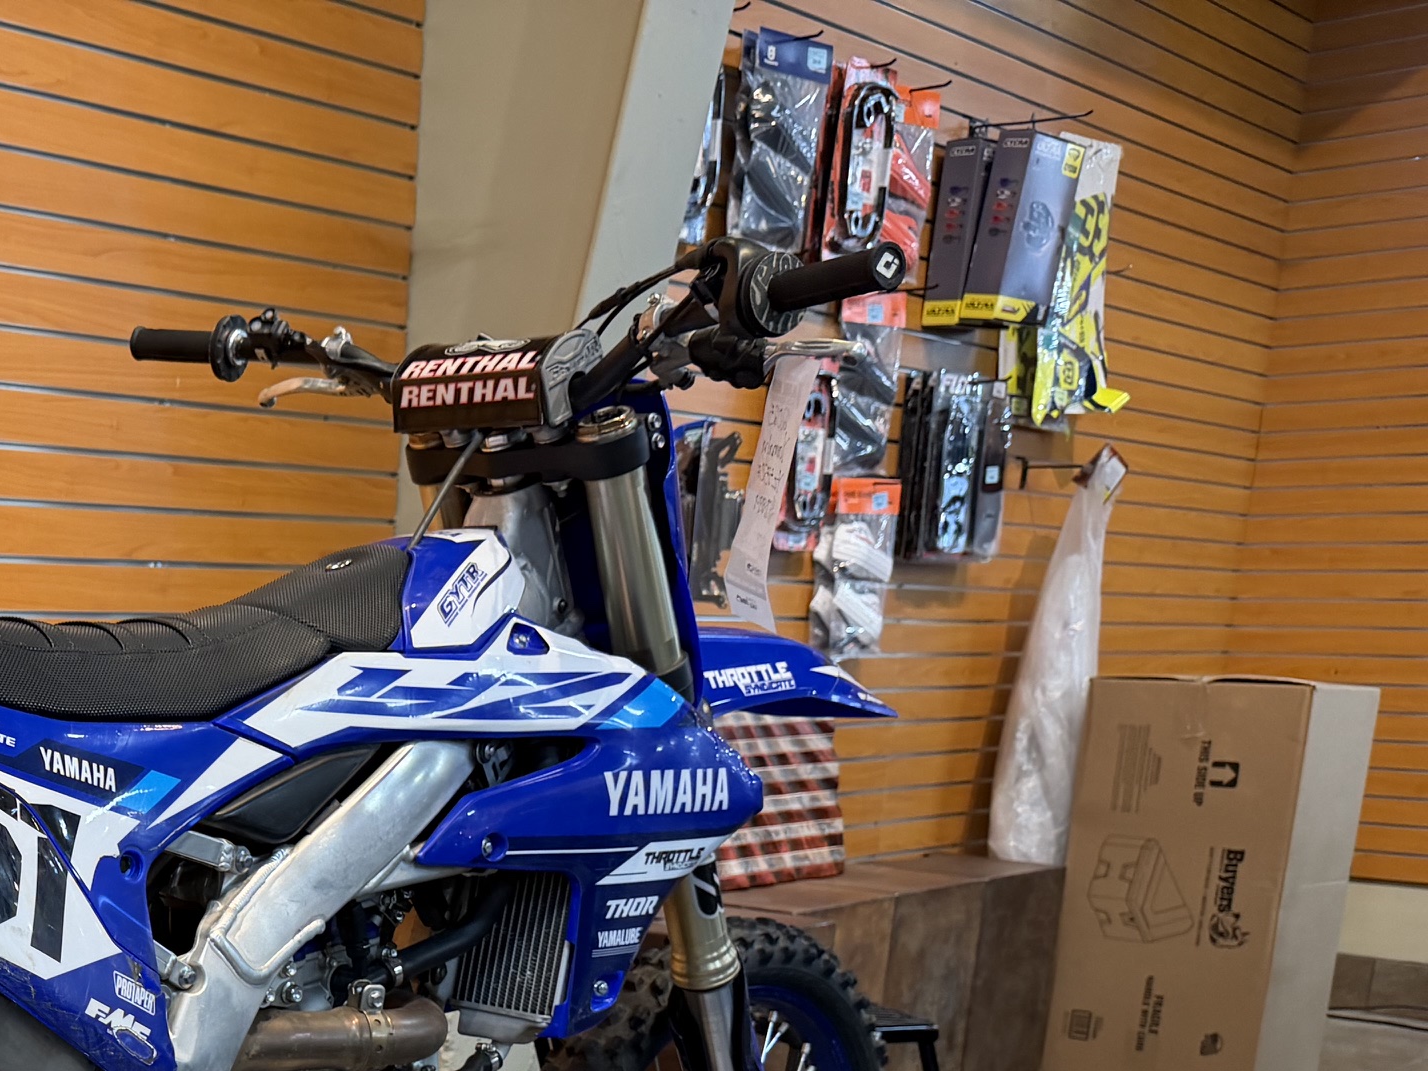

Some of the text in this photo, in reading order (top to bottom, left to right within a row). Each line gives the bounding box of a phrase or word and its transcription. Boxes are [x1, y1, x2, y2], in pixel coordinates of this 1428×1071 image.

[400, 351, 539, 380] RENTHAL
[400, 376, 535, 409] RENTHAL
[438, 563, 483, 622] GYTR
[703, 661, 793, 690] THROTTLE
[40, 747, 117, 793] YAMAHA
[1193, 739, 1212, 807] THIS SIDE UP
[604, 768, 729, 817] YAMAHA
[1218, 848, 1245, 913] Buyers
[605, 895, 659, 919] THOR
[598, 927, 643, 948] YAMALUBE
[116, 974, 155, 1014] PROTAPER
[85, 998, 151, 1041] FMF
